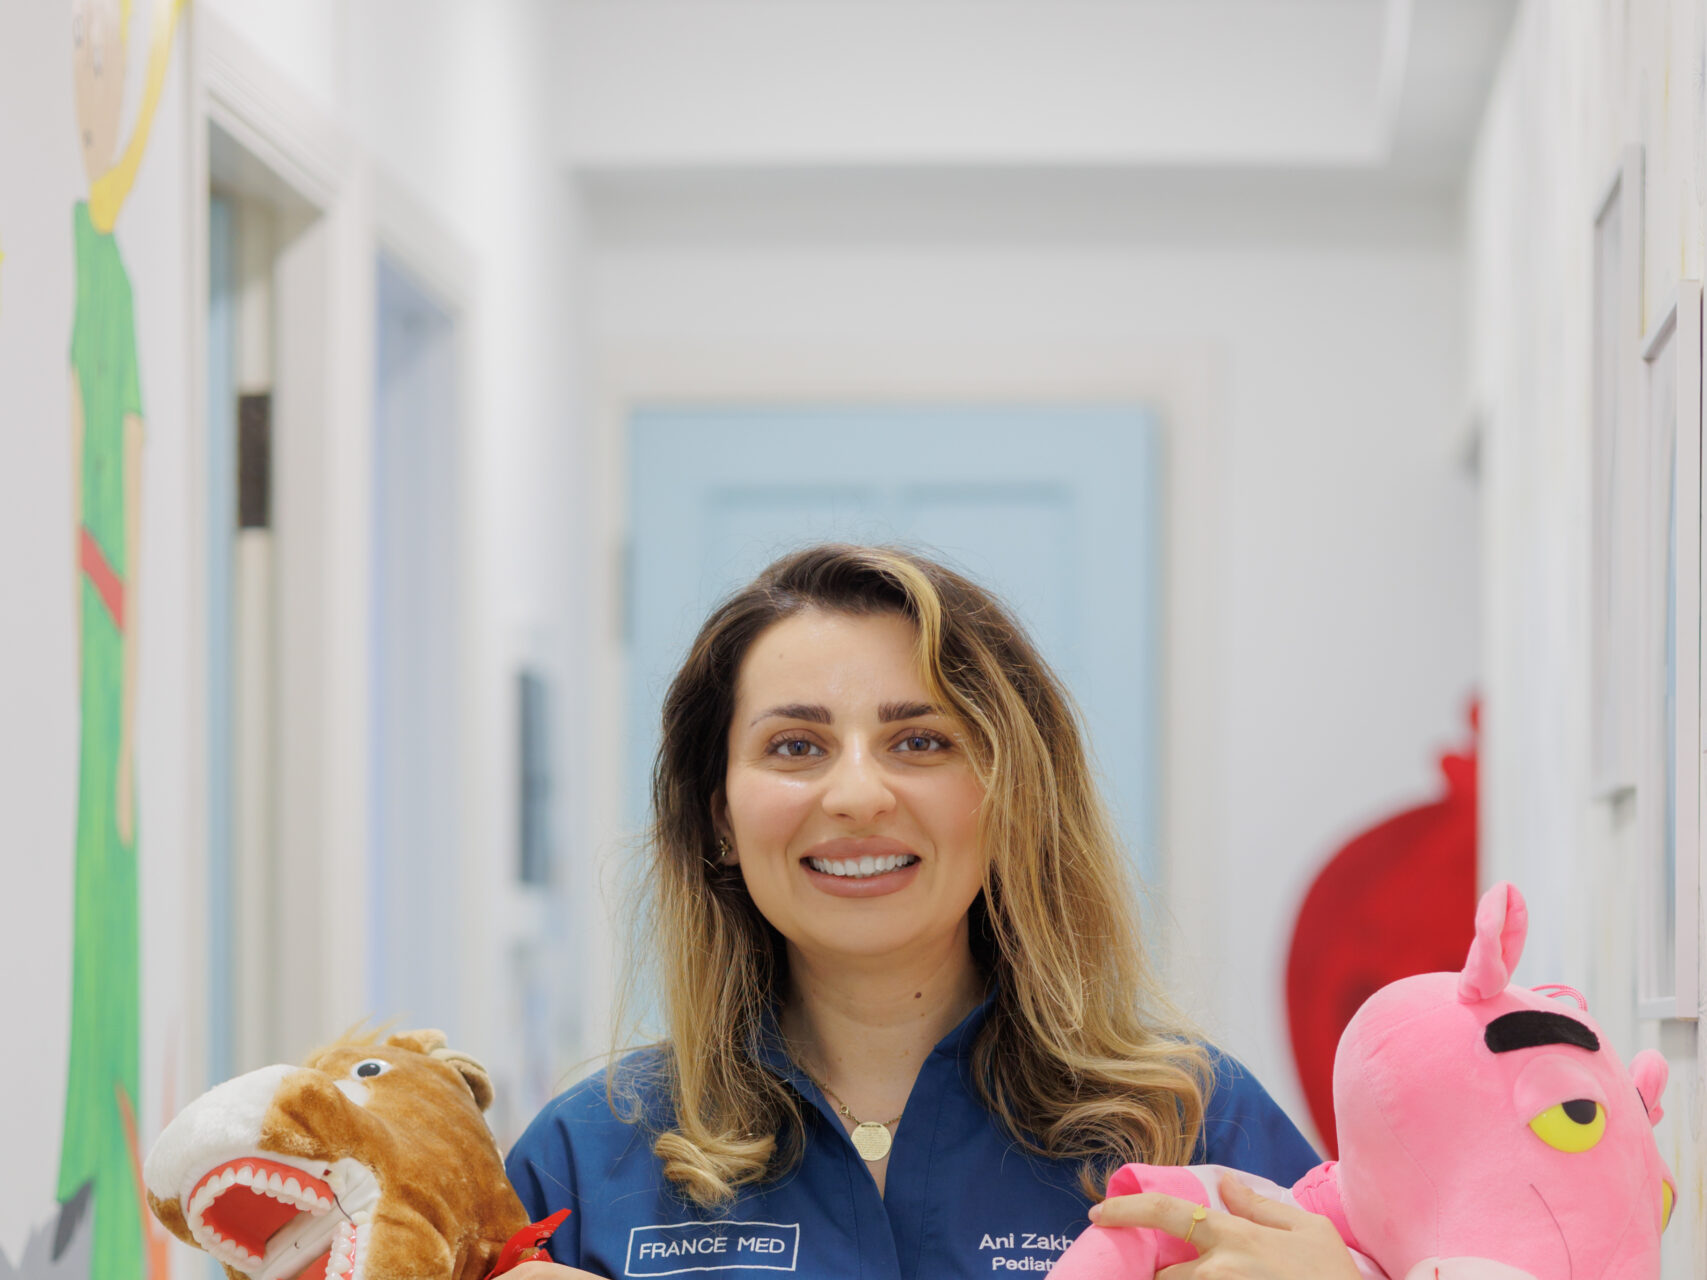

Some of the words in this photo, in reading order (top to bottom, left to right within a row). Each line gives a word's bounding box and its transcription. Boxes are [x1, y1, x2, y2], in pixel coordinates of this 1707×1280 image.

[639, 1237, 728, 1260] FRANCE
[737, 1237, 786, 1254] MED
[979, 1233, 1015, 1250] Ani
